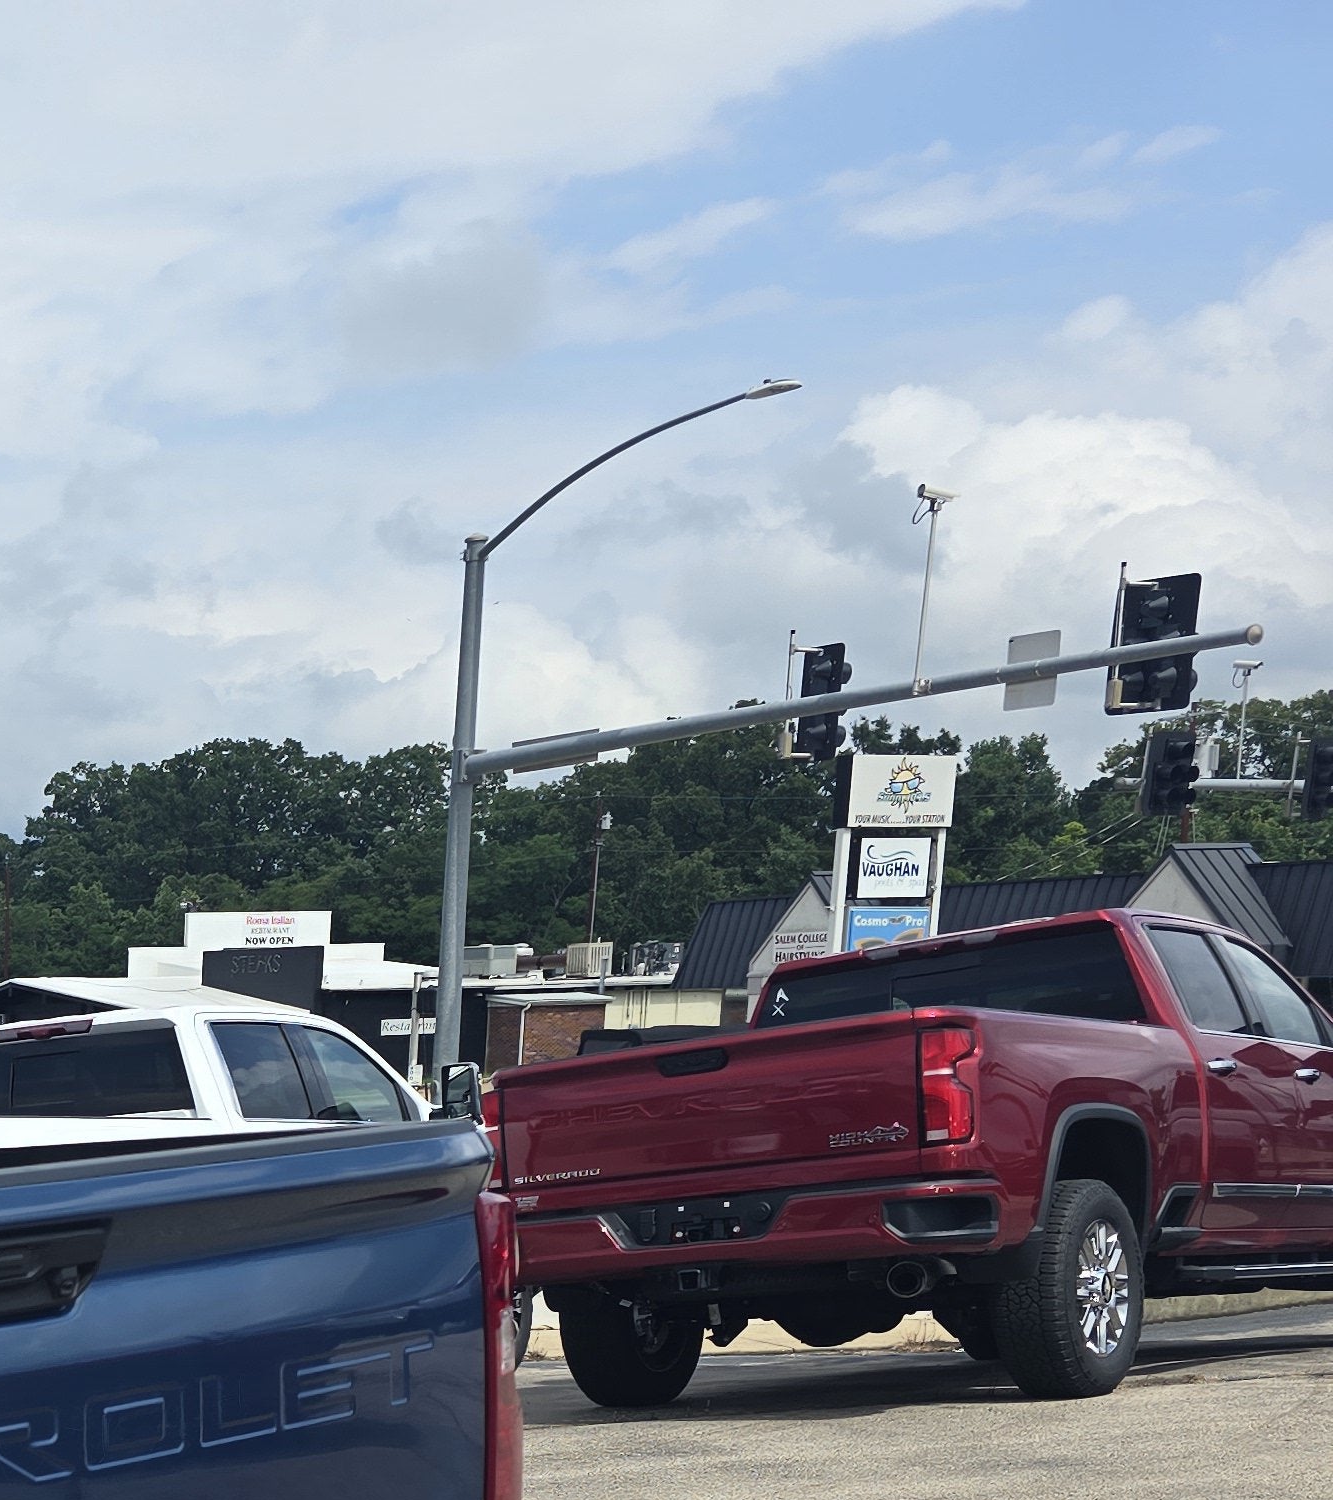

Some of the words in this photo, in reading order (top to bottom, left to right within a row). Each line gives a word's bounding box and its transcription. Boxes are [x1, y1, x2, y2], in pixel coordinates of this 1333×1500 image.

[854, 814, 871, 824] YOUR
[921, 814, 946, 824] STATION
[862, 861, 920, 877] VAUGHAN
[246, 915, 269, 925] Roma
[853, 914, 890, 927] Cosmo
[245, 936, 267, 945] NOW
[269, 936, 294, 945] OPEN
[774, 934, 796, 945] SALEM
[797, 932, 828, 944] COLLEGE
[230, 953, 283, 974] STEAKS
[514, 1168, 601, 1185] SILVERADO
